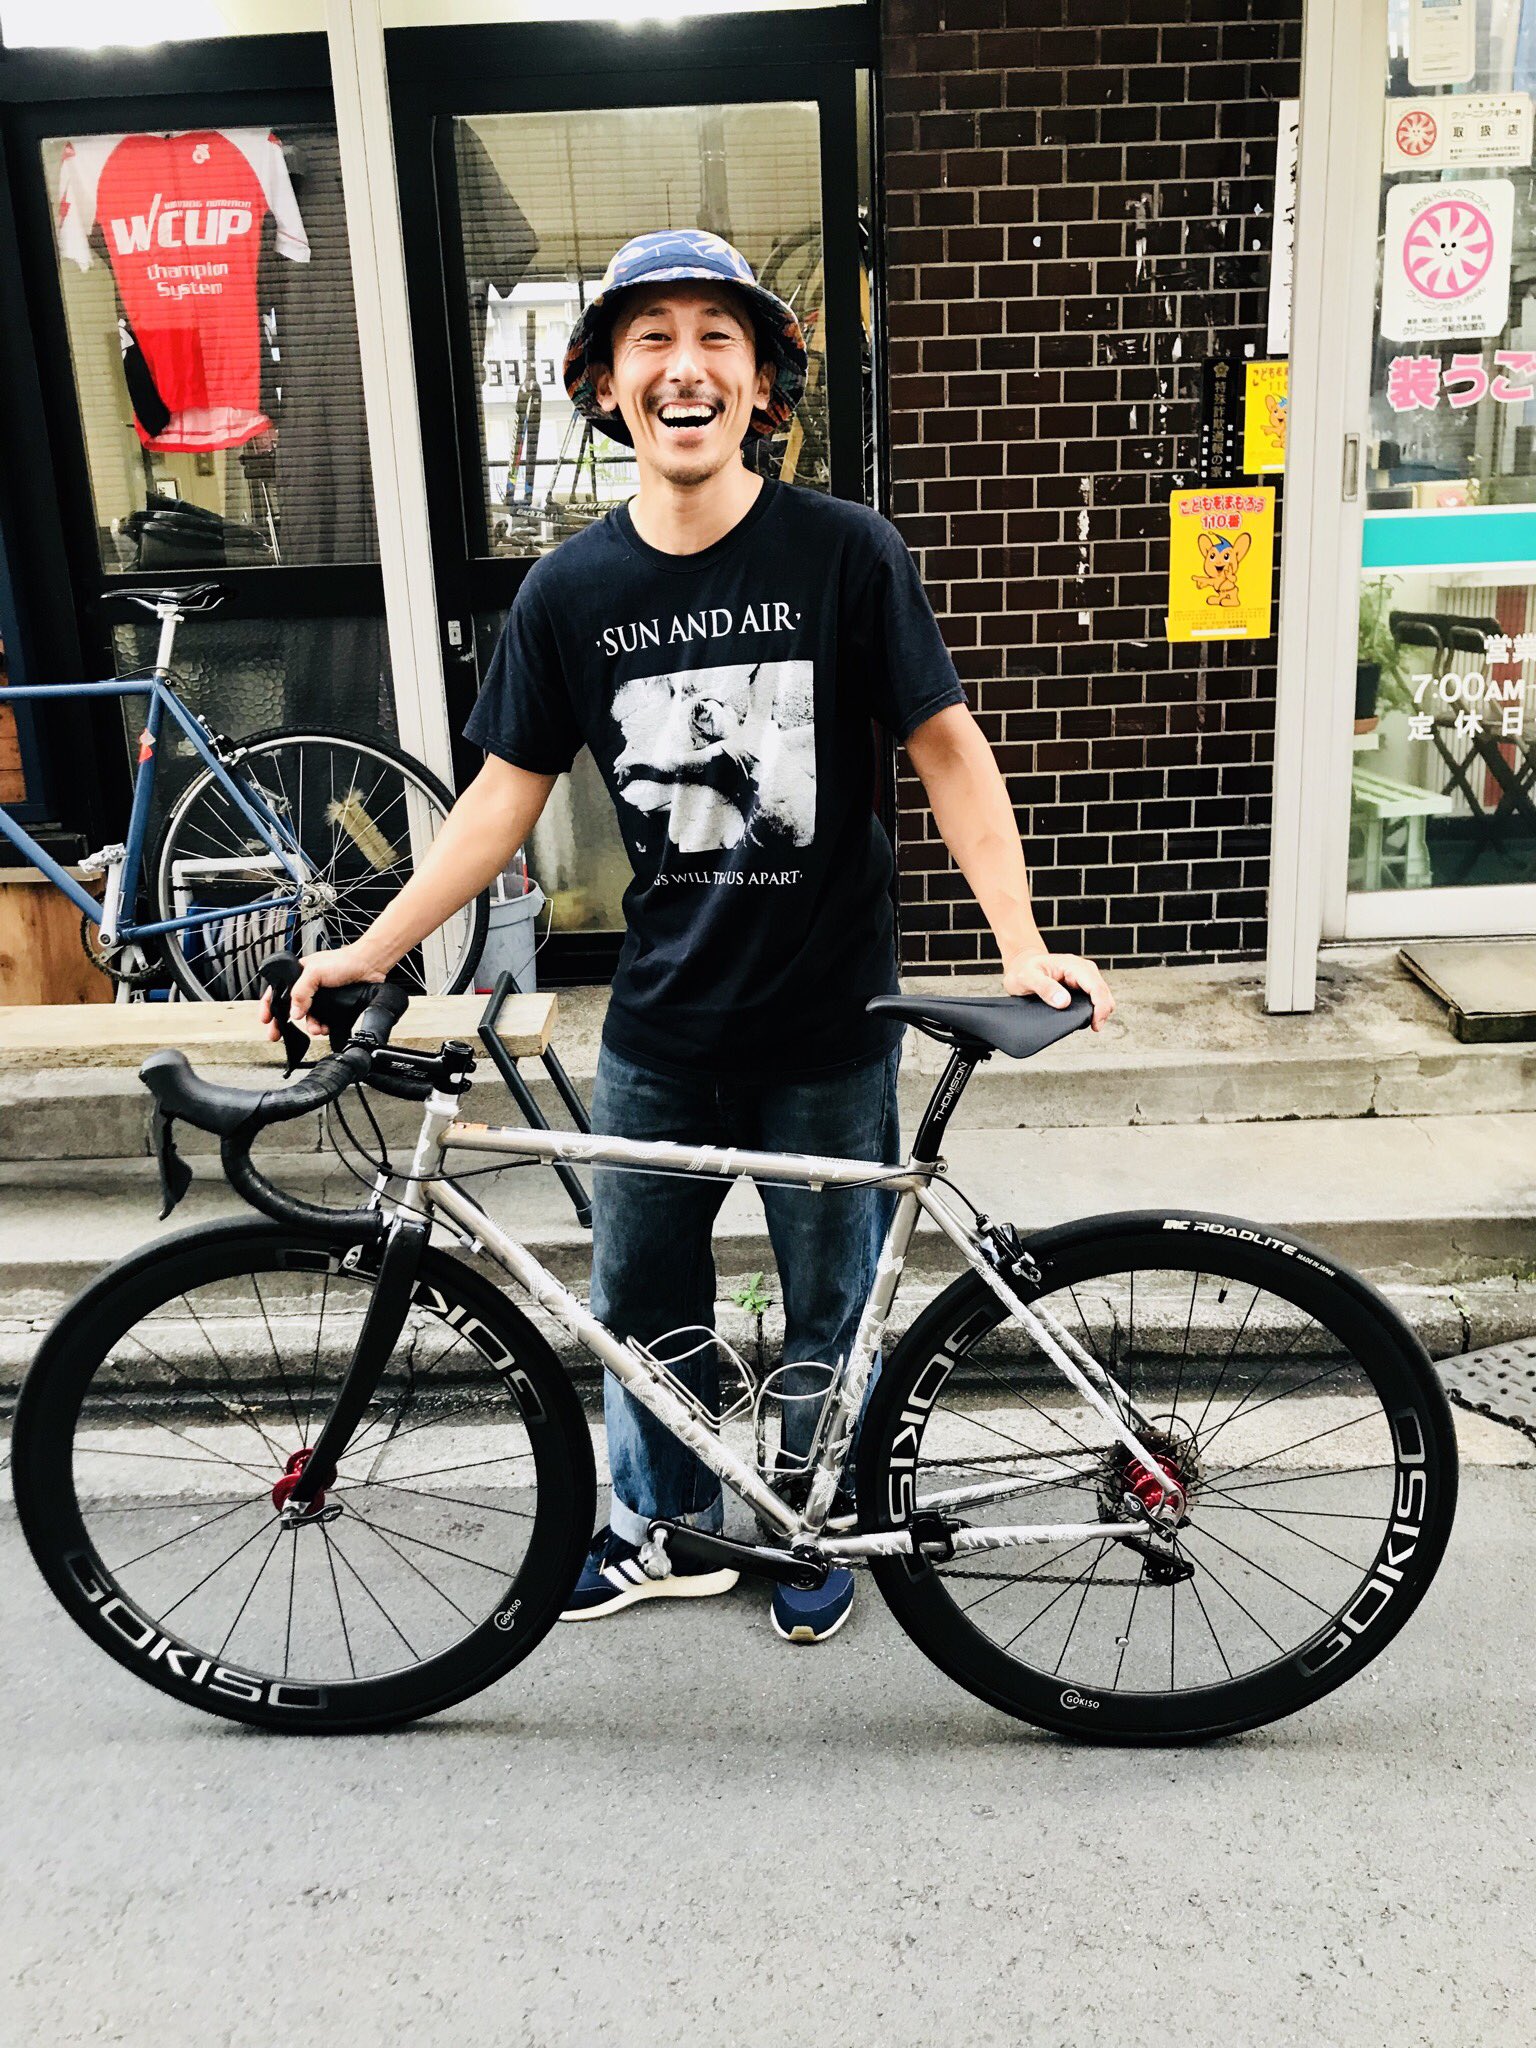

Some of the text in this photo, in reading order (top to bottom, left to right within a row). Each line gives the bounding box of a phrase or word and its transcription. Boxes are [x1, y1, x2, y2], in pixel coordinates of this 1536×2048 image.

[157, 281, 222, 300] System
[667, 608, 733, 644] AND
[671, 871, 711, 884] WILL
[933, 1061, 968, 1121] THOMSON
[1193, 1221, 1298, 1256] ROADLITE
[1296, 1253, 1314, 1265] MADE
[1317, 1264, 1336, 1277] JAPAN
[1297, 1406, 1427, 1677] GOKISO
[64, 1552, 328, 1709] GOKISO
[1066, 1695, 1100, 1709] GOKISO
